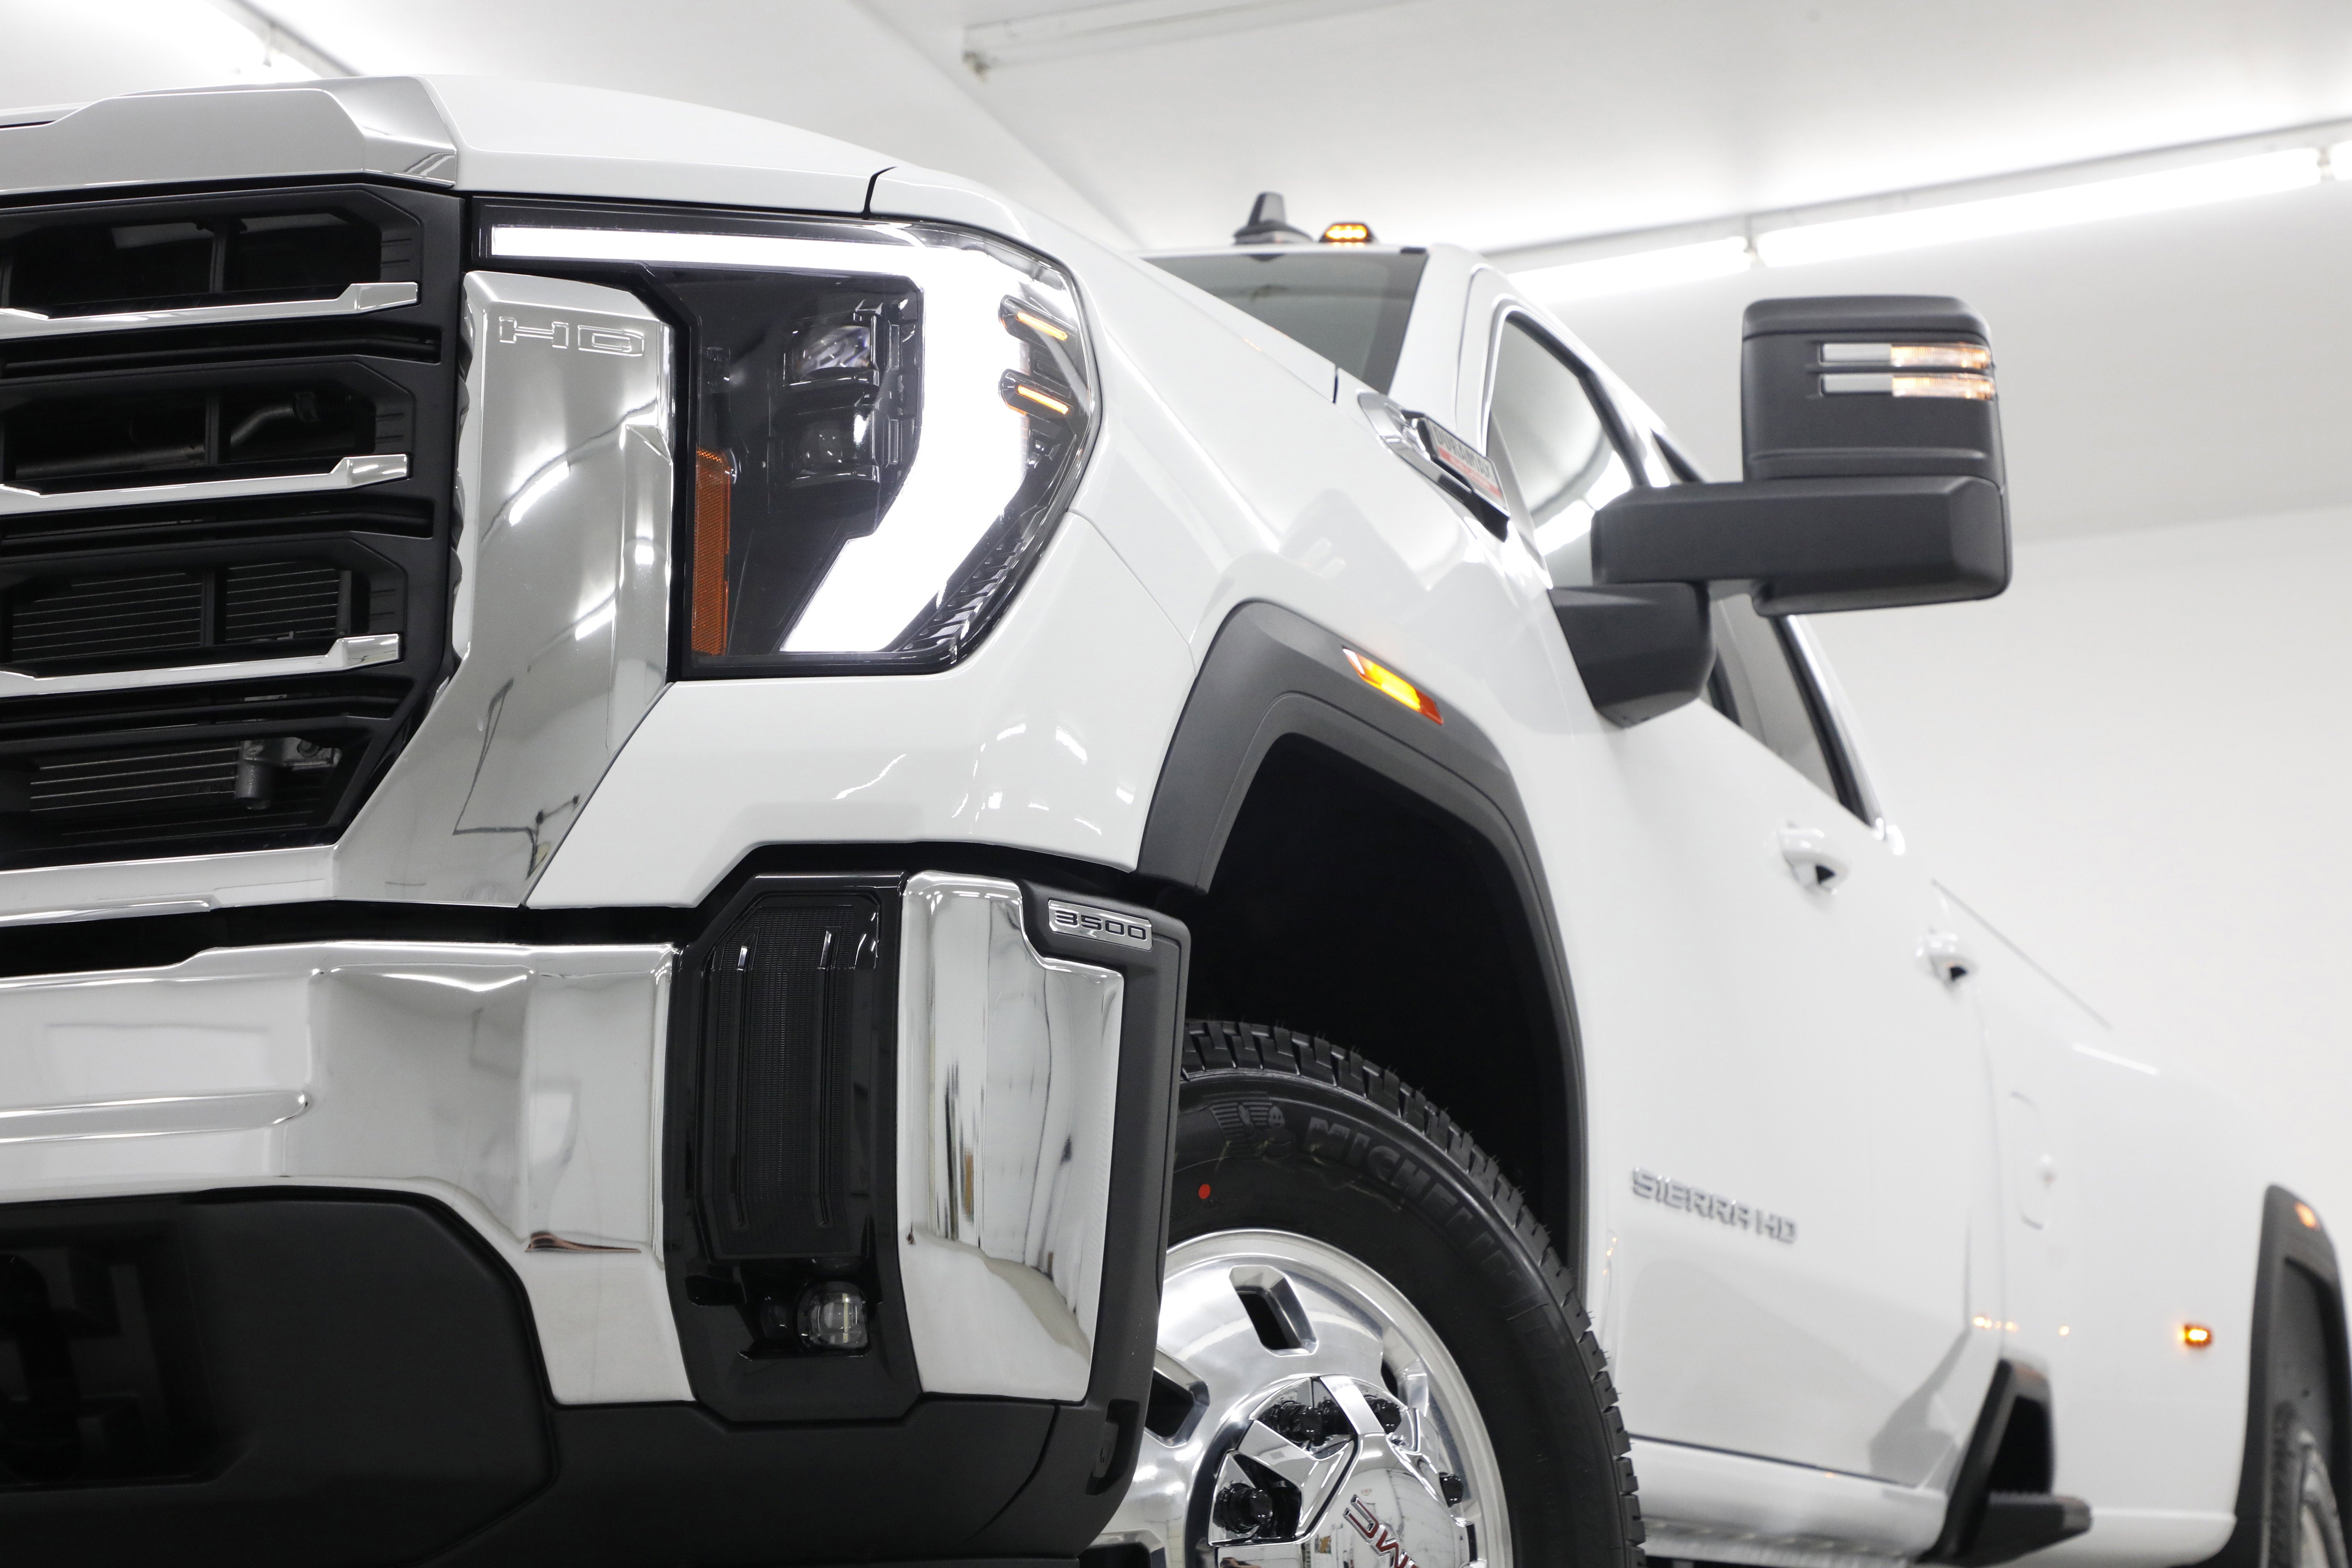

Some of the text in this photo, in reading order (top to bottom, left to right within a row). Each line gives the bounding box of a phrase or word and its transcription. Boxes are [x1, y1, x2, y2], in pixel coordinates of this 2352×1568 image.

[499, 316, 645, 357] HD
[1054, 910, 1147, 941] 3500
[1632, 1166, 1797, 1245] SIERRA HD
[1343, 1494, 1420, 1568] MC
